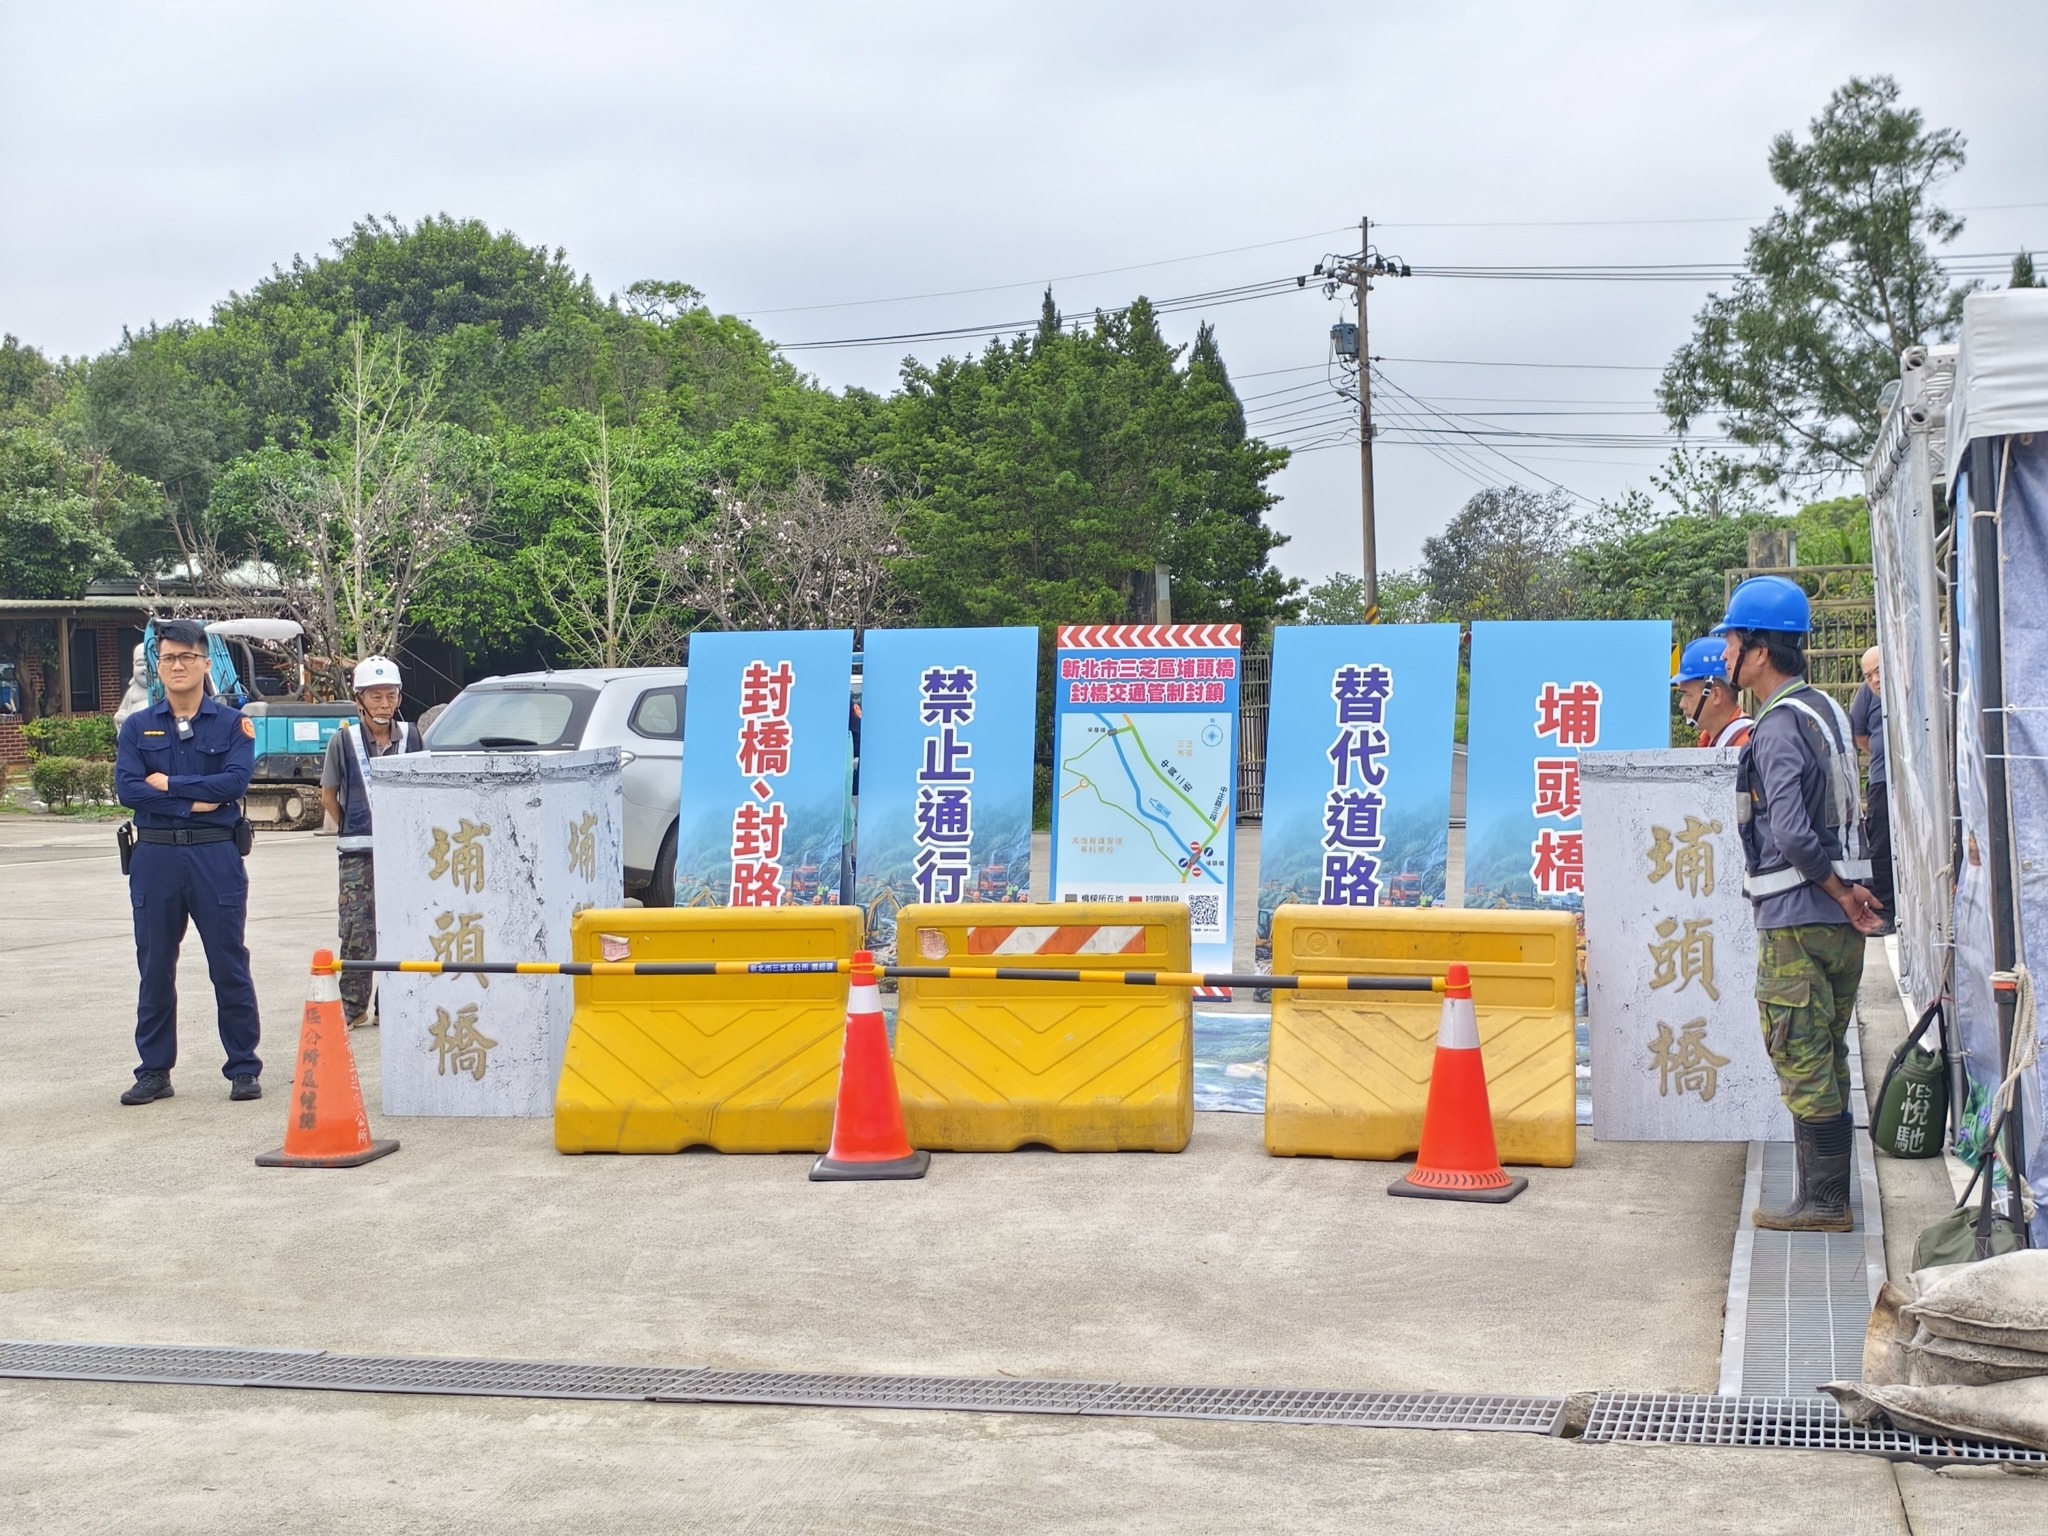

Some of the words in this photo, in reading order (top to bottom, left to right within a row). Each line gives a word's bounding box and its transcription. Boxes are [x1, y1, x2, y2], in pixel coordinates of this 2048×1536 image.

[1062, 658, 1235, 680] 新北市三芝區埔頭橋
[1071, 682, 1225, 704] 封橋交通管制封鎖
[915, 668, 974, 904] 禁止通行
[1321, 666, 1390, 907] 替代道路
[1533, 684, 1600, 893] 埔頭橋
[428, 818, 498, 1081] 埔頭橋
[1647, 815, 1731, 1102] 埔頭橋
[1905, 1080, 1932, 1098] YES
